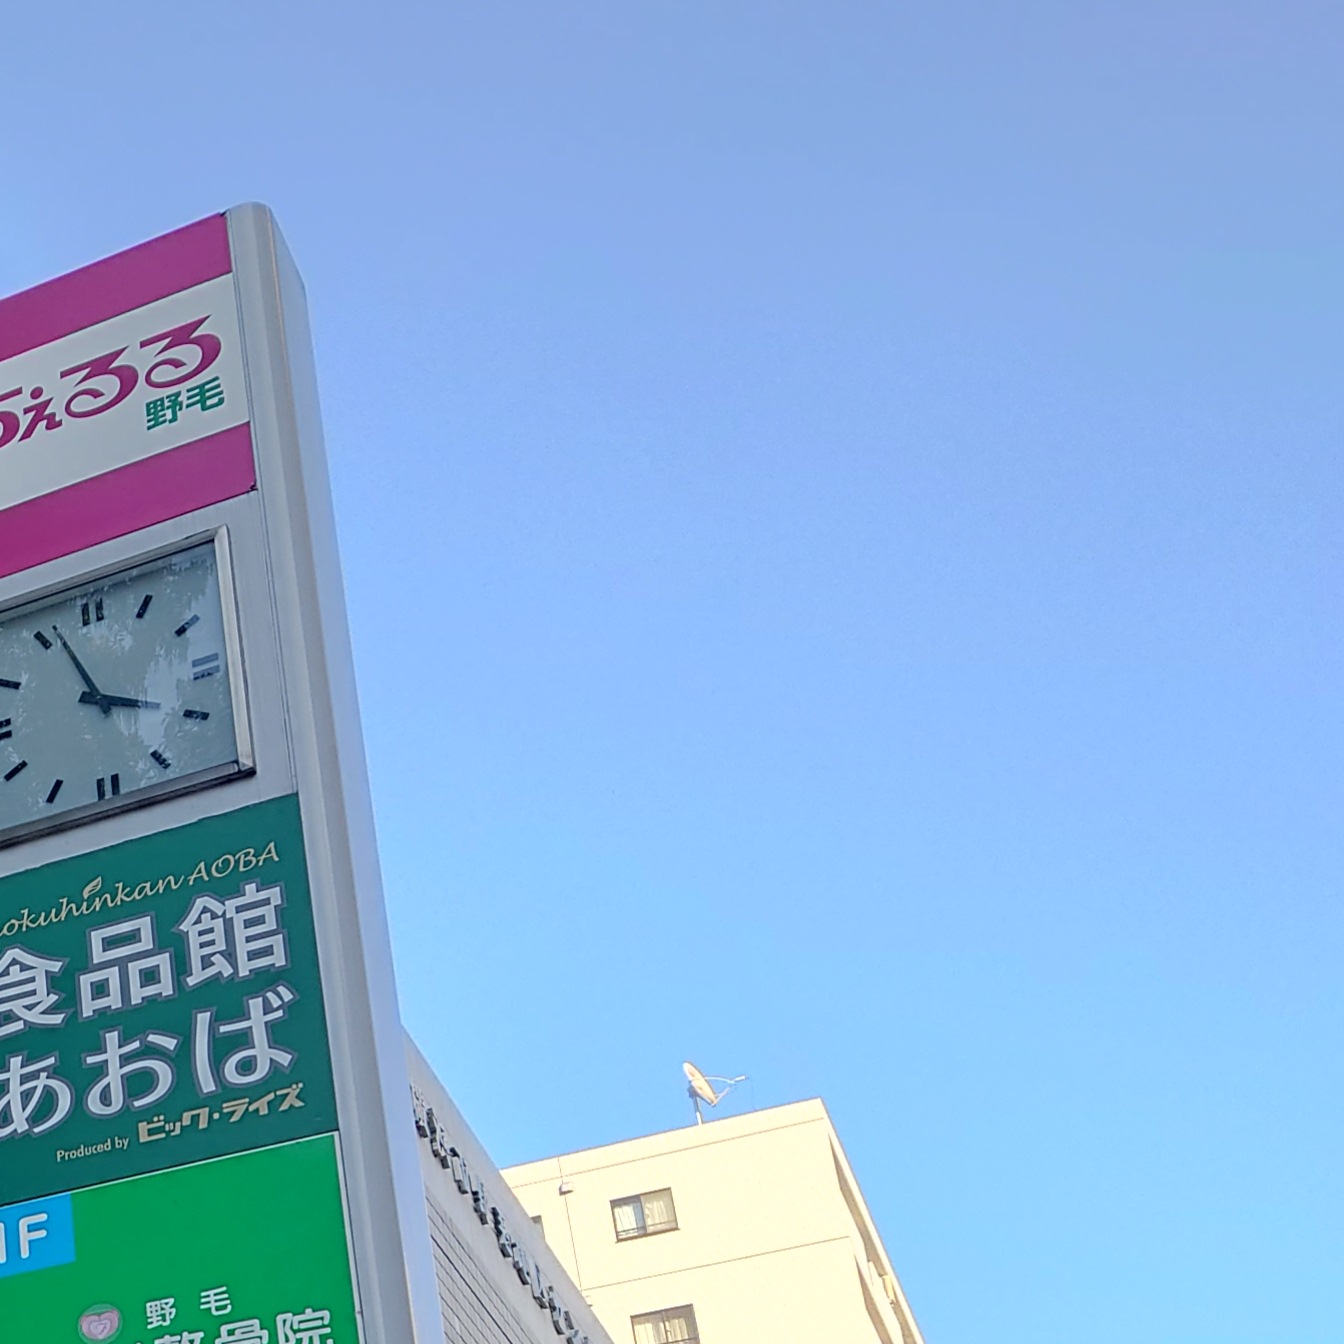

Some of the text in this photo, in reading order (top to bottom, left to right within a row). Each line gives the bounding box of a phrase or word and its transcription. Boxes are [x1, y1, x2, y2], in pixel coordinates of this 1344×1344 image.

[145, 376, 226, 431] 野毛
[187, 841, 280, 886] AOBA
[56, 1138, 112, 1163] Produced
[114, 1135, 130, 1150] by
